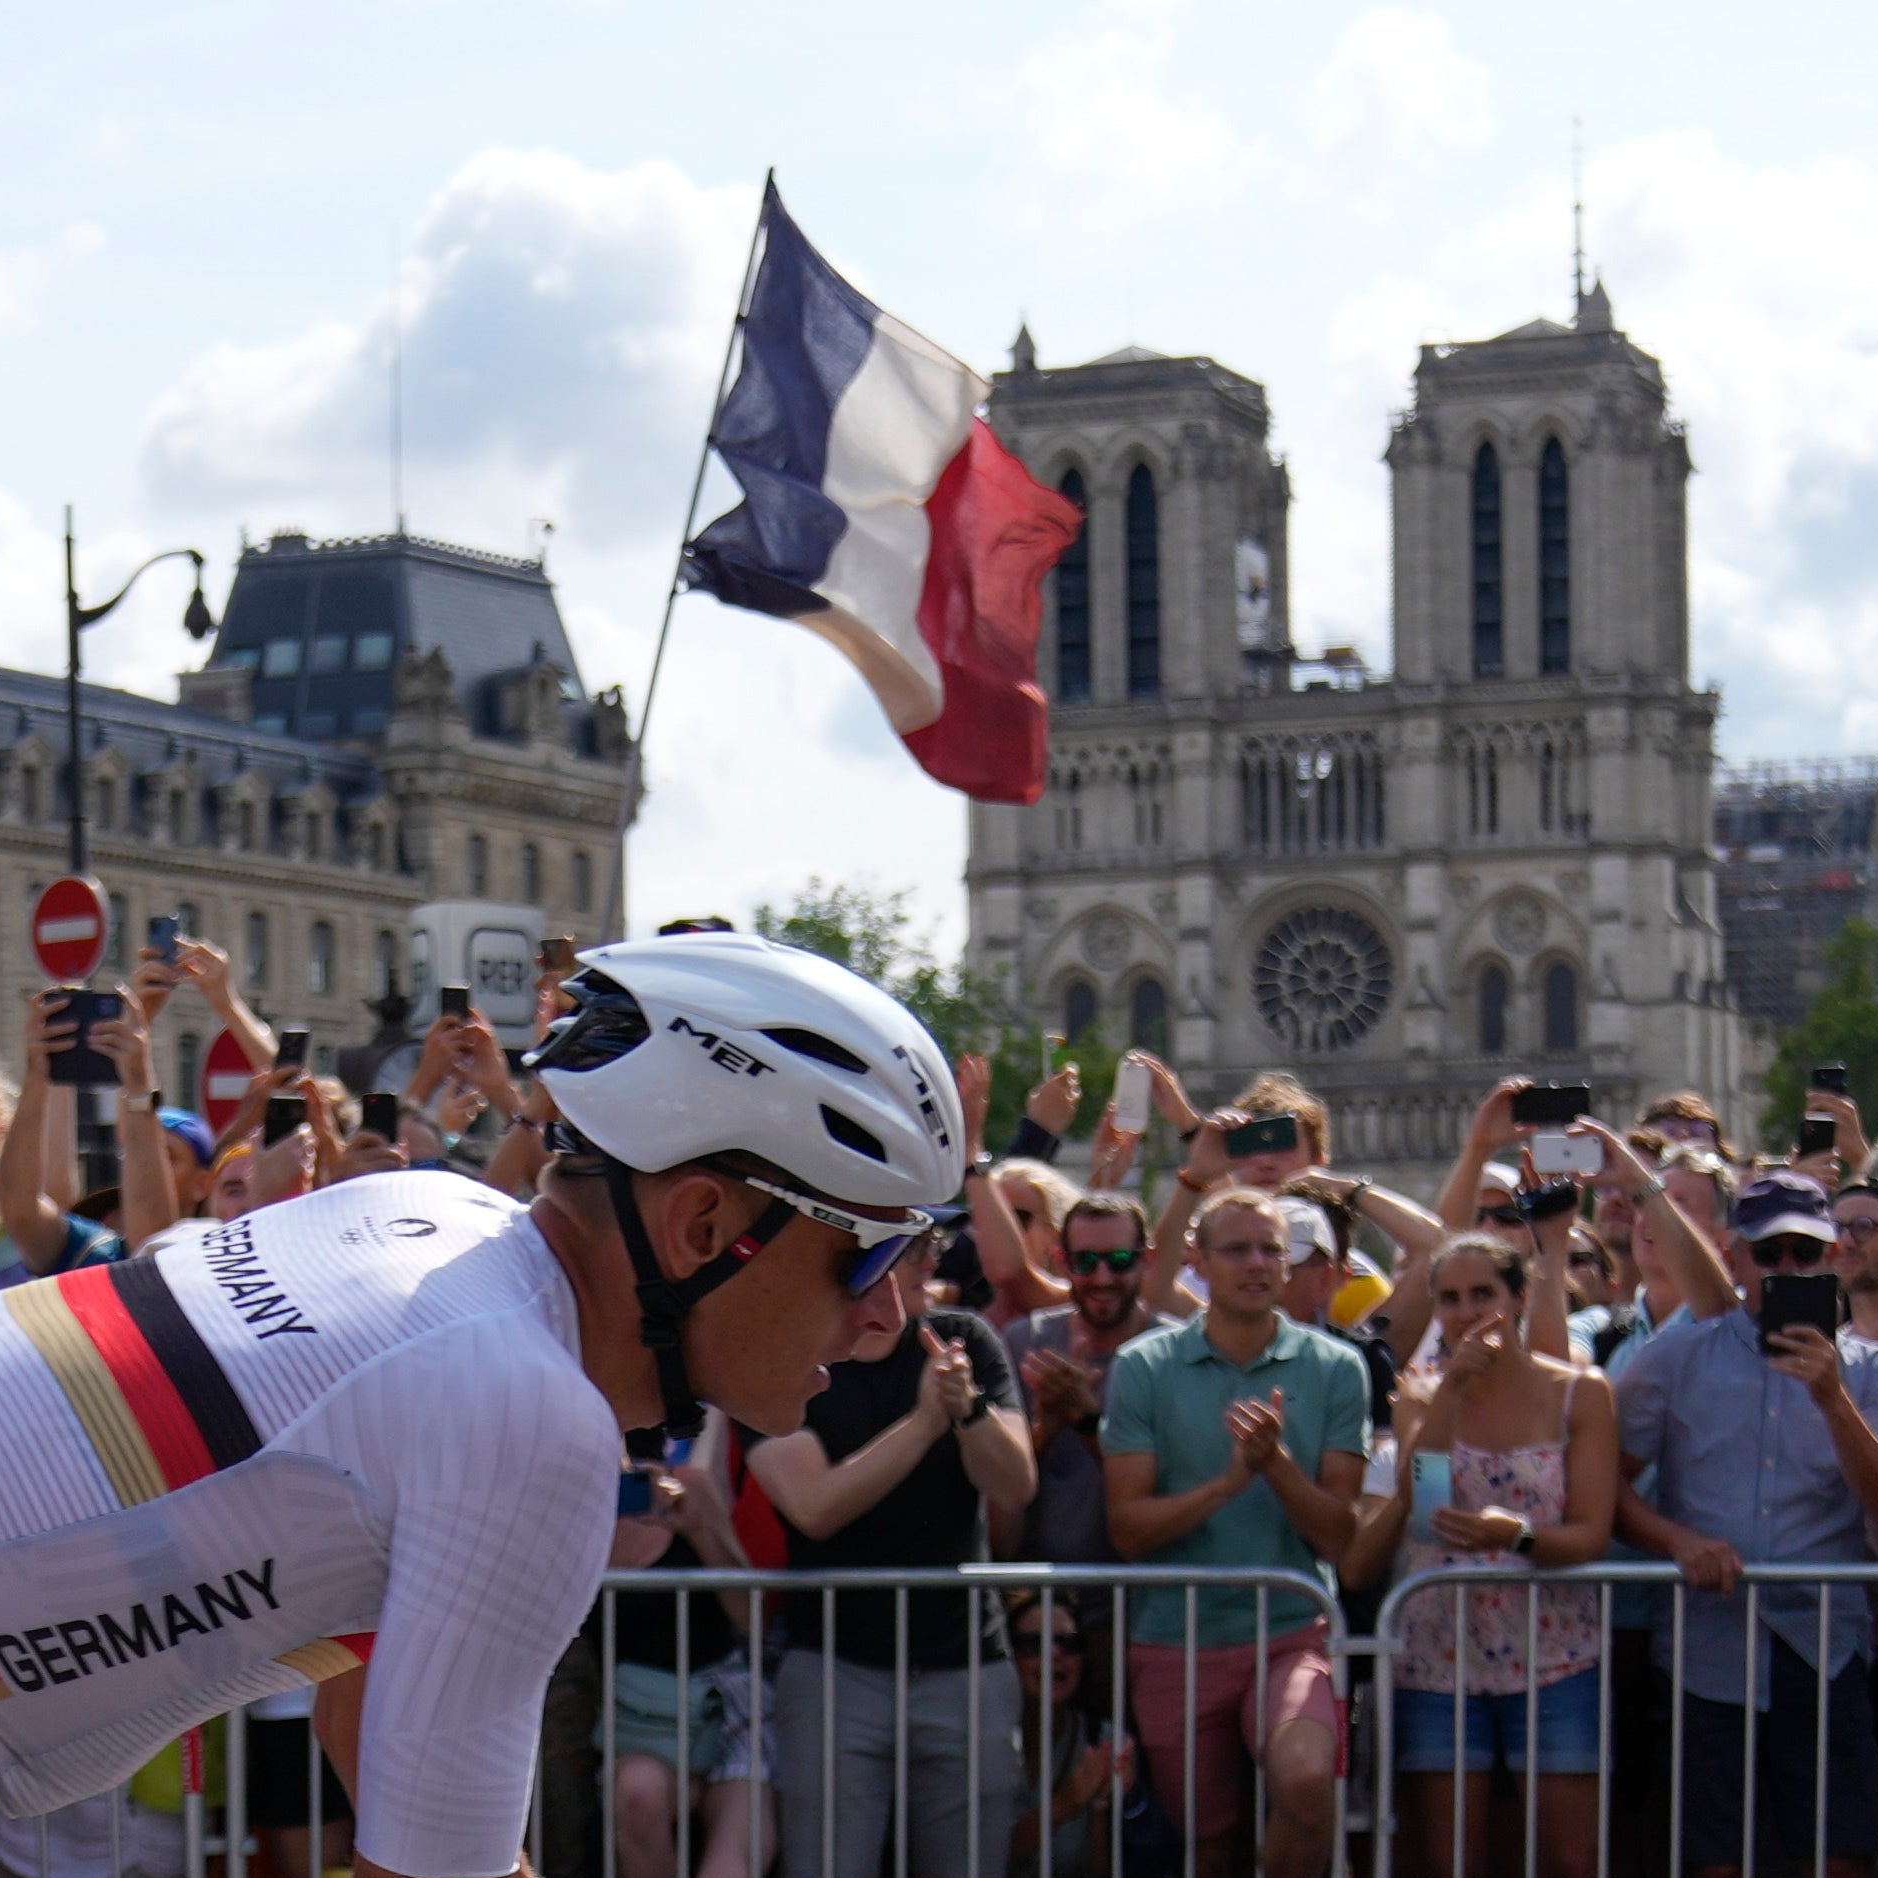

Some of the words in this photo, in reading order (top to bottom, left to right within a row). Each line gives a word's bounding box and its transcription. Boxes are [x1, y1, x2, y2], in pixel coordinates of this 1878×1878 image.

[668, 1016, 777, 1077] MET
[891, 1044, 951, 1152] MET
[202, 1219, 317, 1341] GERMANY
